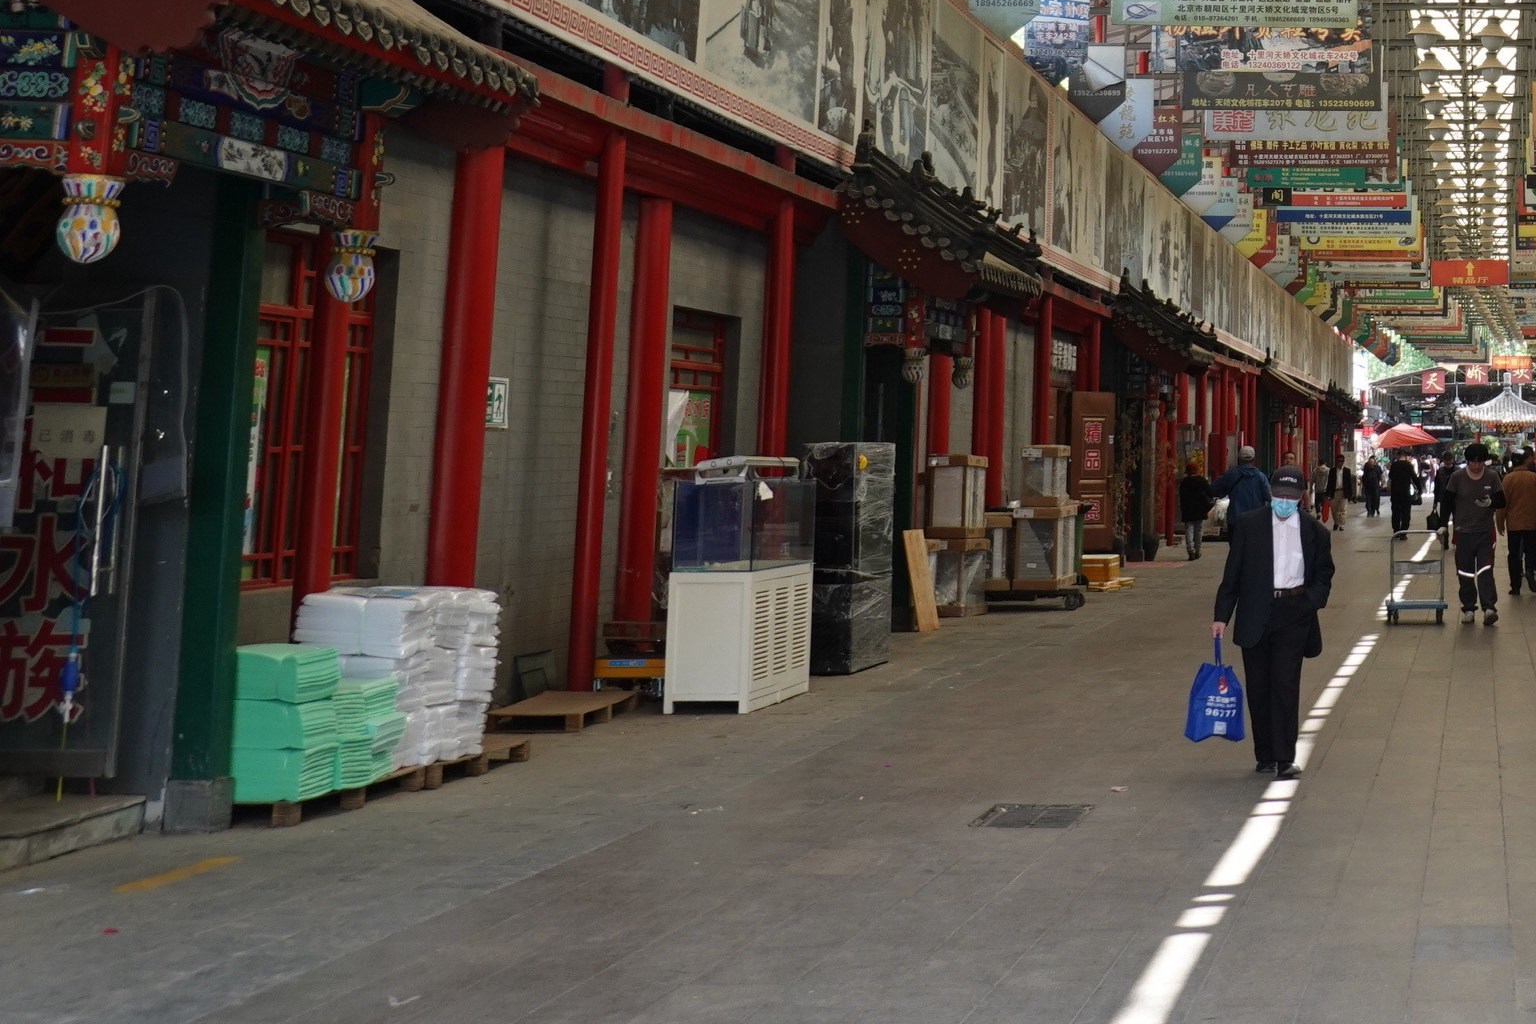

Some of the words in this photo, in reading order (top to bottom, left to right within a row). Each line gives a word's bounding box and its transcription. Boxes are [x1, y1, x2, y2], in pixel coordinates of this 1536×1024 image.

[975, 0, 1034, 7] 18945266669
[1425, 373, 1443, 391] 天
[1205, 707, 1237, 718] 96777
